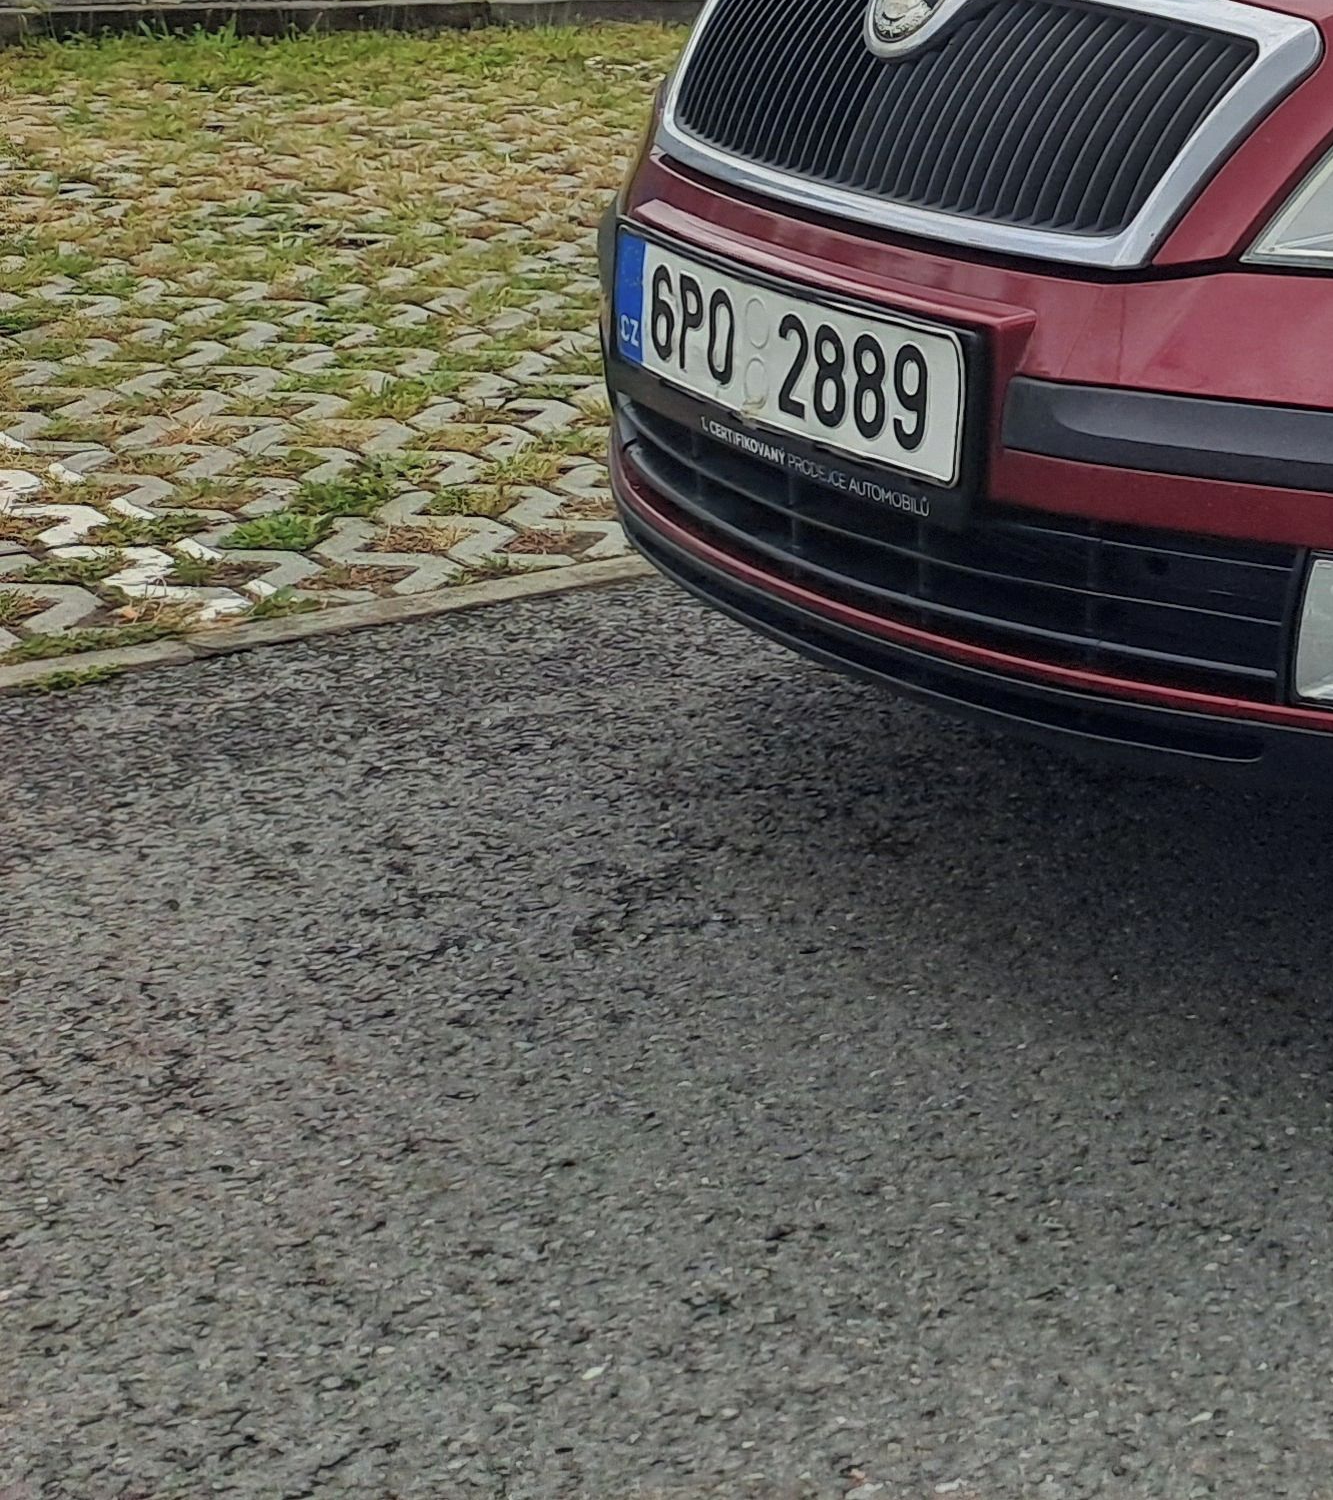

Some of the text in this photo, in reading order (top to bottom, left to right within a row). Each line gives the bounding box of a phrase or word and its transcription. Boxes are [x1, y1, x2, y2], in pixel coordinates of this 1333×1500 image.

[620, 316, 641, 348] CZ
[777, 312, 928, 451] 2889
[710, 420, 786, 465] CERTIFIKOVANÝ
[786, 451, 848, 491] PRODEJCE
[848, 478, 931, 518] AUTOMOBILŮ
